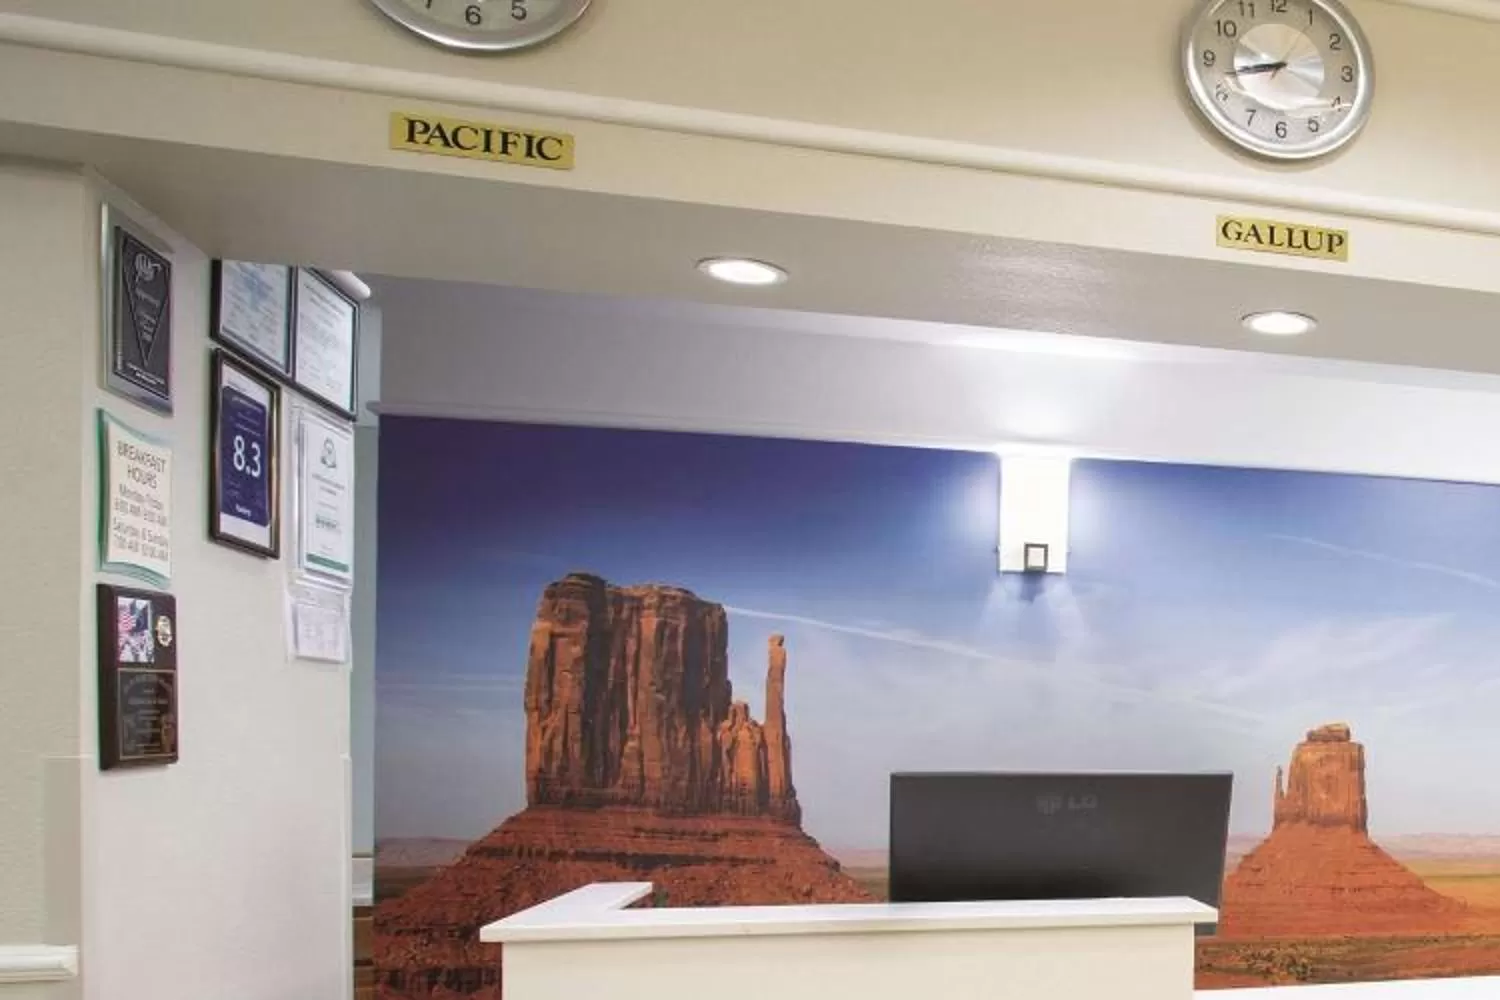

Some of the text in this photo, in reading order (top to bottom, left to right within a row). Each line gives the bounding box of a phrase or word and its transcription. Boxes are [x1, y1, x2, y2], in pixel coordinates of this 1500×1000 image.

[465, 5, 482, 25] 6
[511, 0, 527, 21] 5
[1238, 0, 1255, 18] 11
[1270, 0, 1288, 13] 12
[1307, 8, 1314, 26] 1
[1215, 19, 1238, 38] 10
[1328, 33, 1342, 51] 2
[1203, 50, 1216, 67] 9
[1341, 65, 1354, 84] 3
[1245, 109, 1257, 127] 7
[1307, 116, 1320, 133] 5
[403, 116, 564, 162] PACIFIC
[1275, 121, 1288, 139] 6
[1221, 219, 1345, 254] GALLUP
[118, 440, 167, 473] BREAKFAST
[233, 434, 262, 478] 8.3
[127, 463, 158, 490] HOURS
